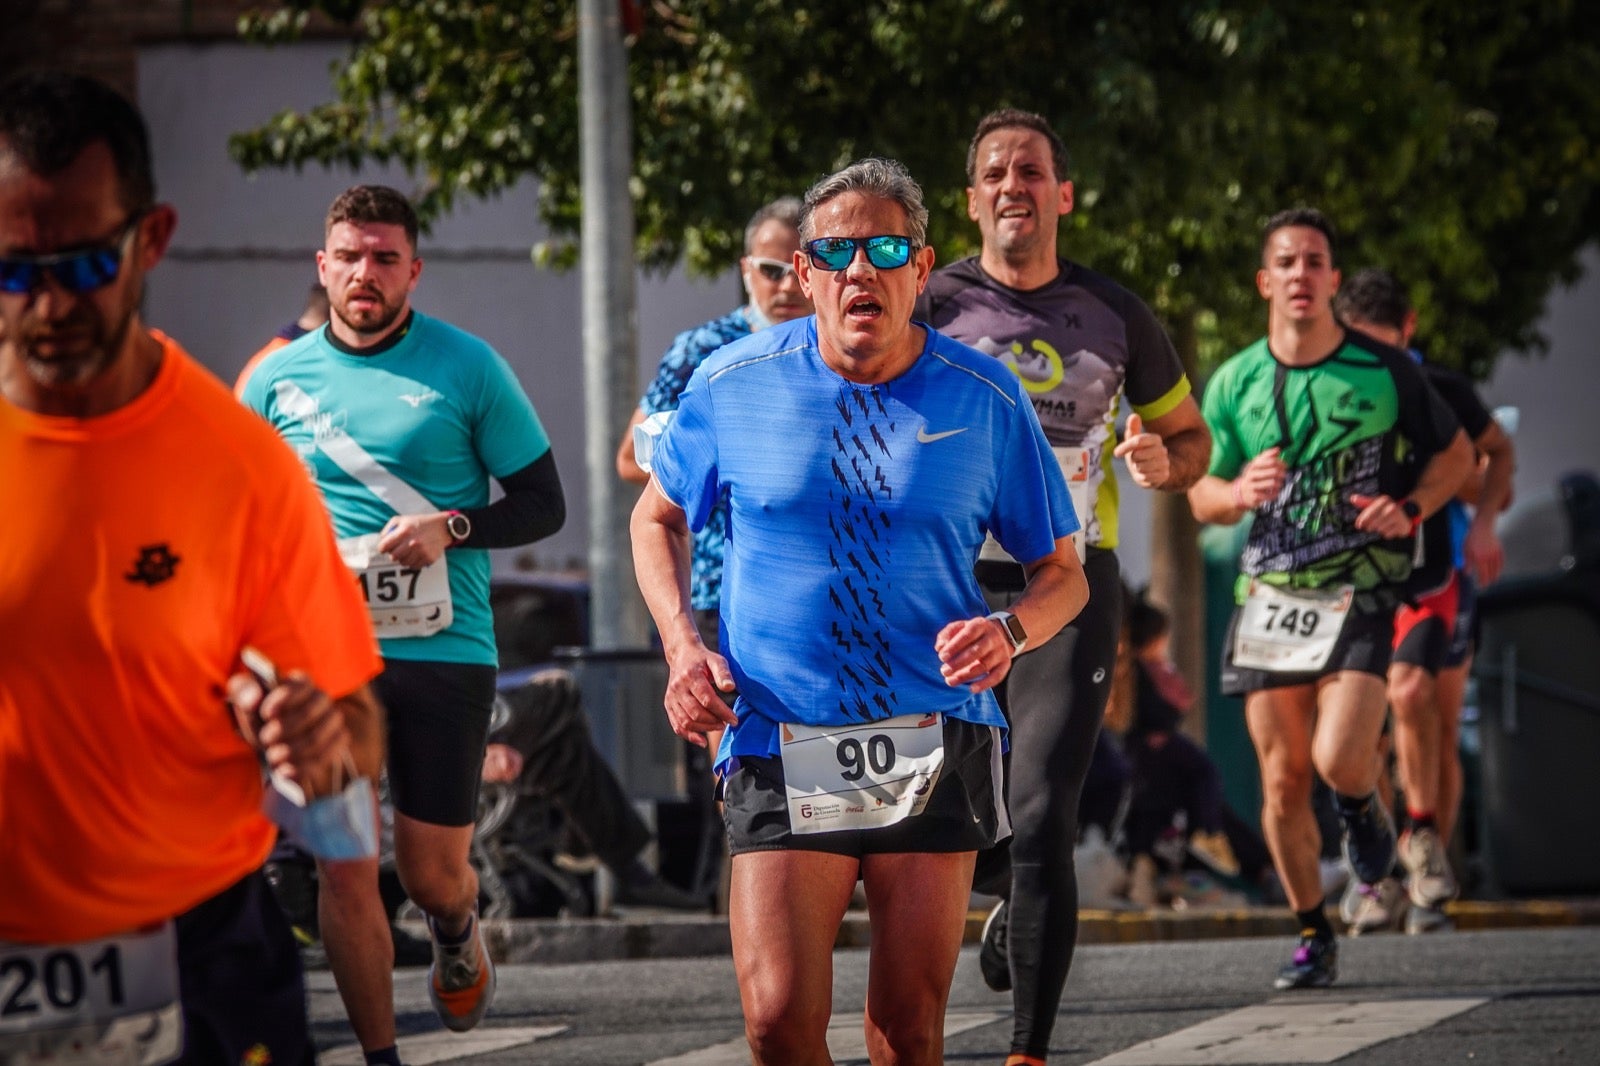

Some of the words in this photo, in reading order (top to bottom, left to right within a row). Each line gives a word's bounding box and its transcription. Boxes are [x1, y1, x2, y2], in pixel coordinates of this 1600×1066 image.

[1265, 604, 1321, 637] 749
[836, 734, 896, 781] 90
[0, 945, 124, 1015] 201
